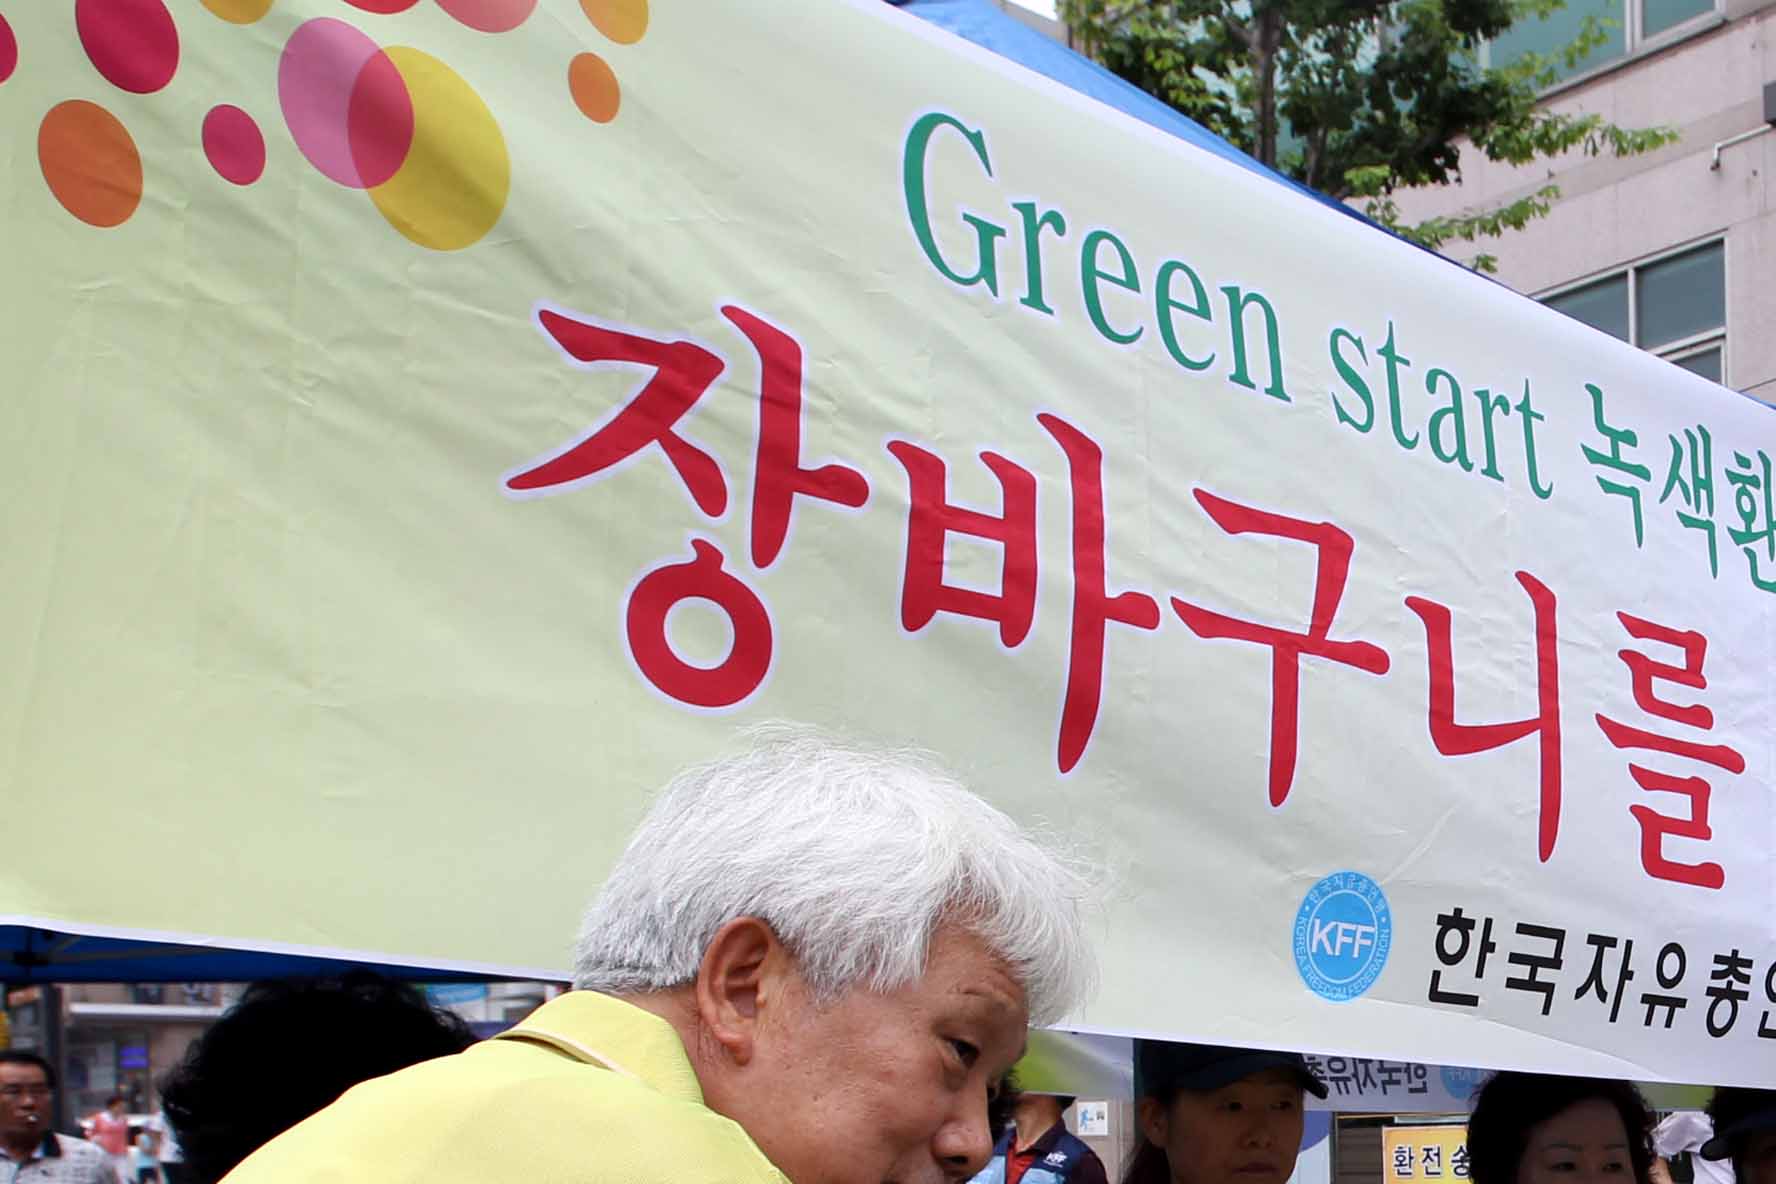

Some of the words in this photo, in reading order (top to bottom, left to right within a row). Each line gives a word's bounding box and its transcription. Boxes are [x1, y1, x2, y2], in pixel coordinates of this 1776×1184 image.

[903, 111, 1291, 402] Green
[1329, 320, 1553, 500] start
[505, 303, 1746, 890] 장바구니를
[1311, 917, 1376, 959] KFF
[1393, 1145, 1442, 1176] 환전
